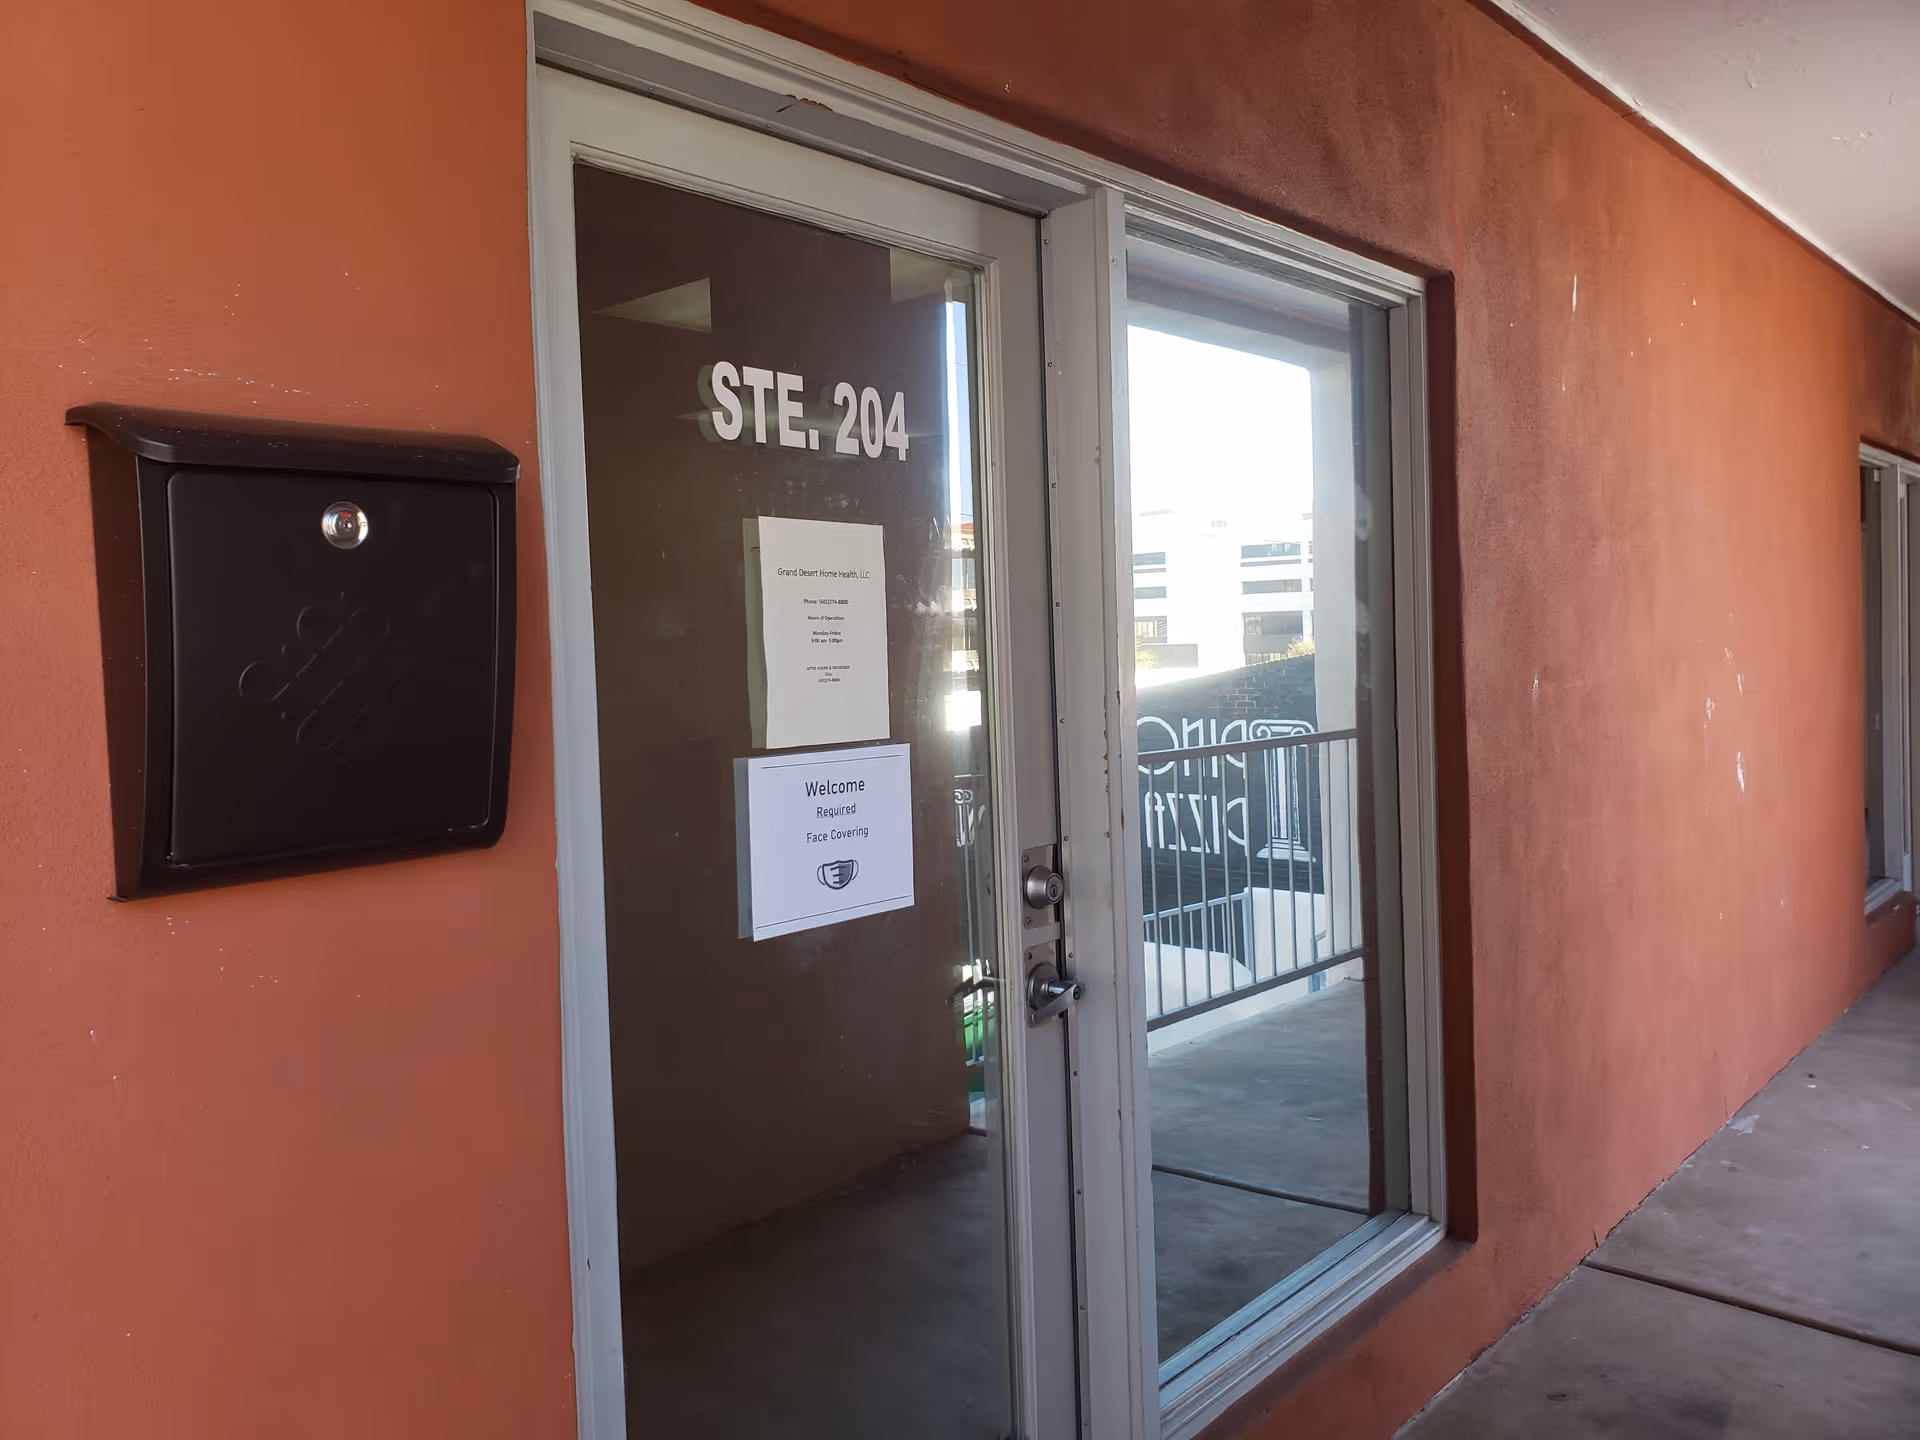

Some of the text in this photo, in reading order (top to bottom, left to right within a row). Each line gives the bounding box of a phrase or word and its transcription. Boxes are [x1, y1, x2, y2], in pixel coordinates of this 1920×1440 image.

[711, 361, 909, 462] STE. 204
[777, 567, 870, 580] Grand Desert Home Health, LLC
[805, 780, 865, 797] Welcome
[816, 802, 856, 819] Required
[806, 826, 869, 844] Face Covering
